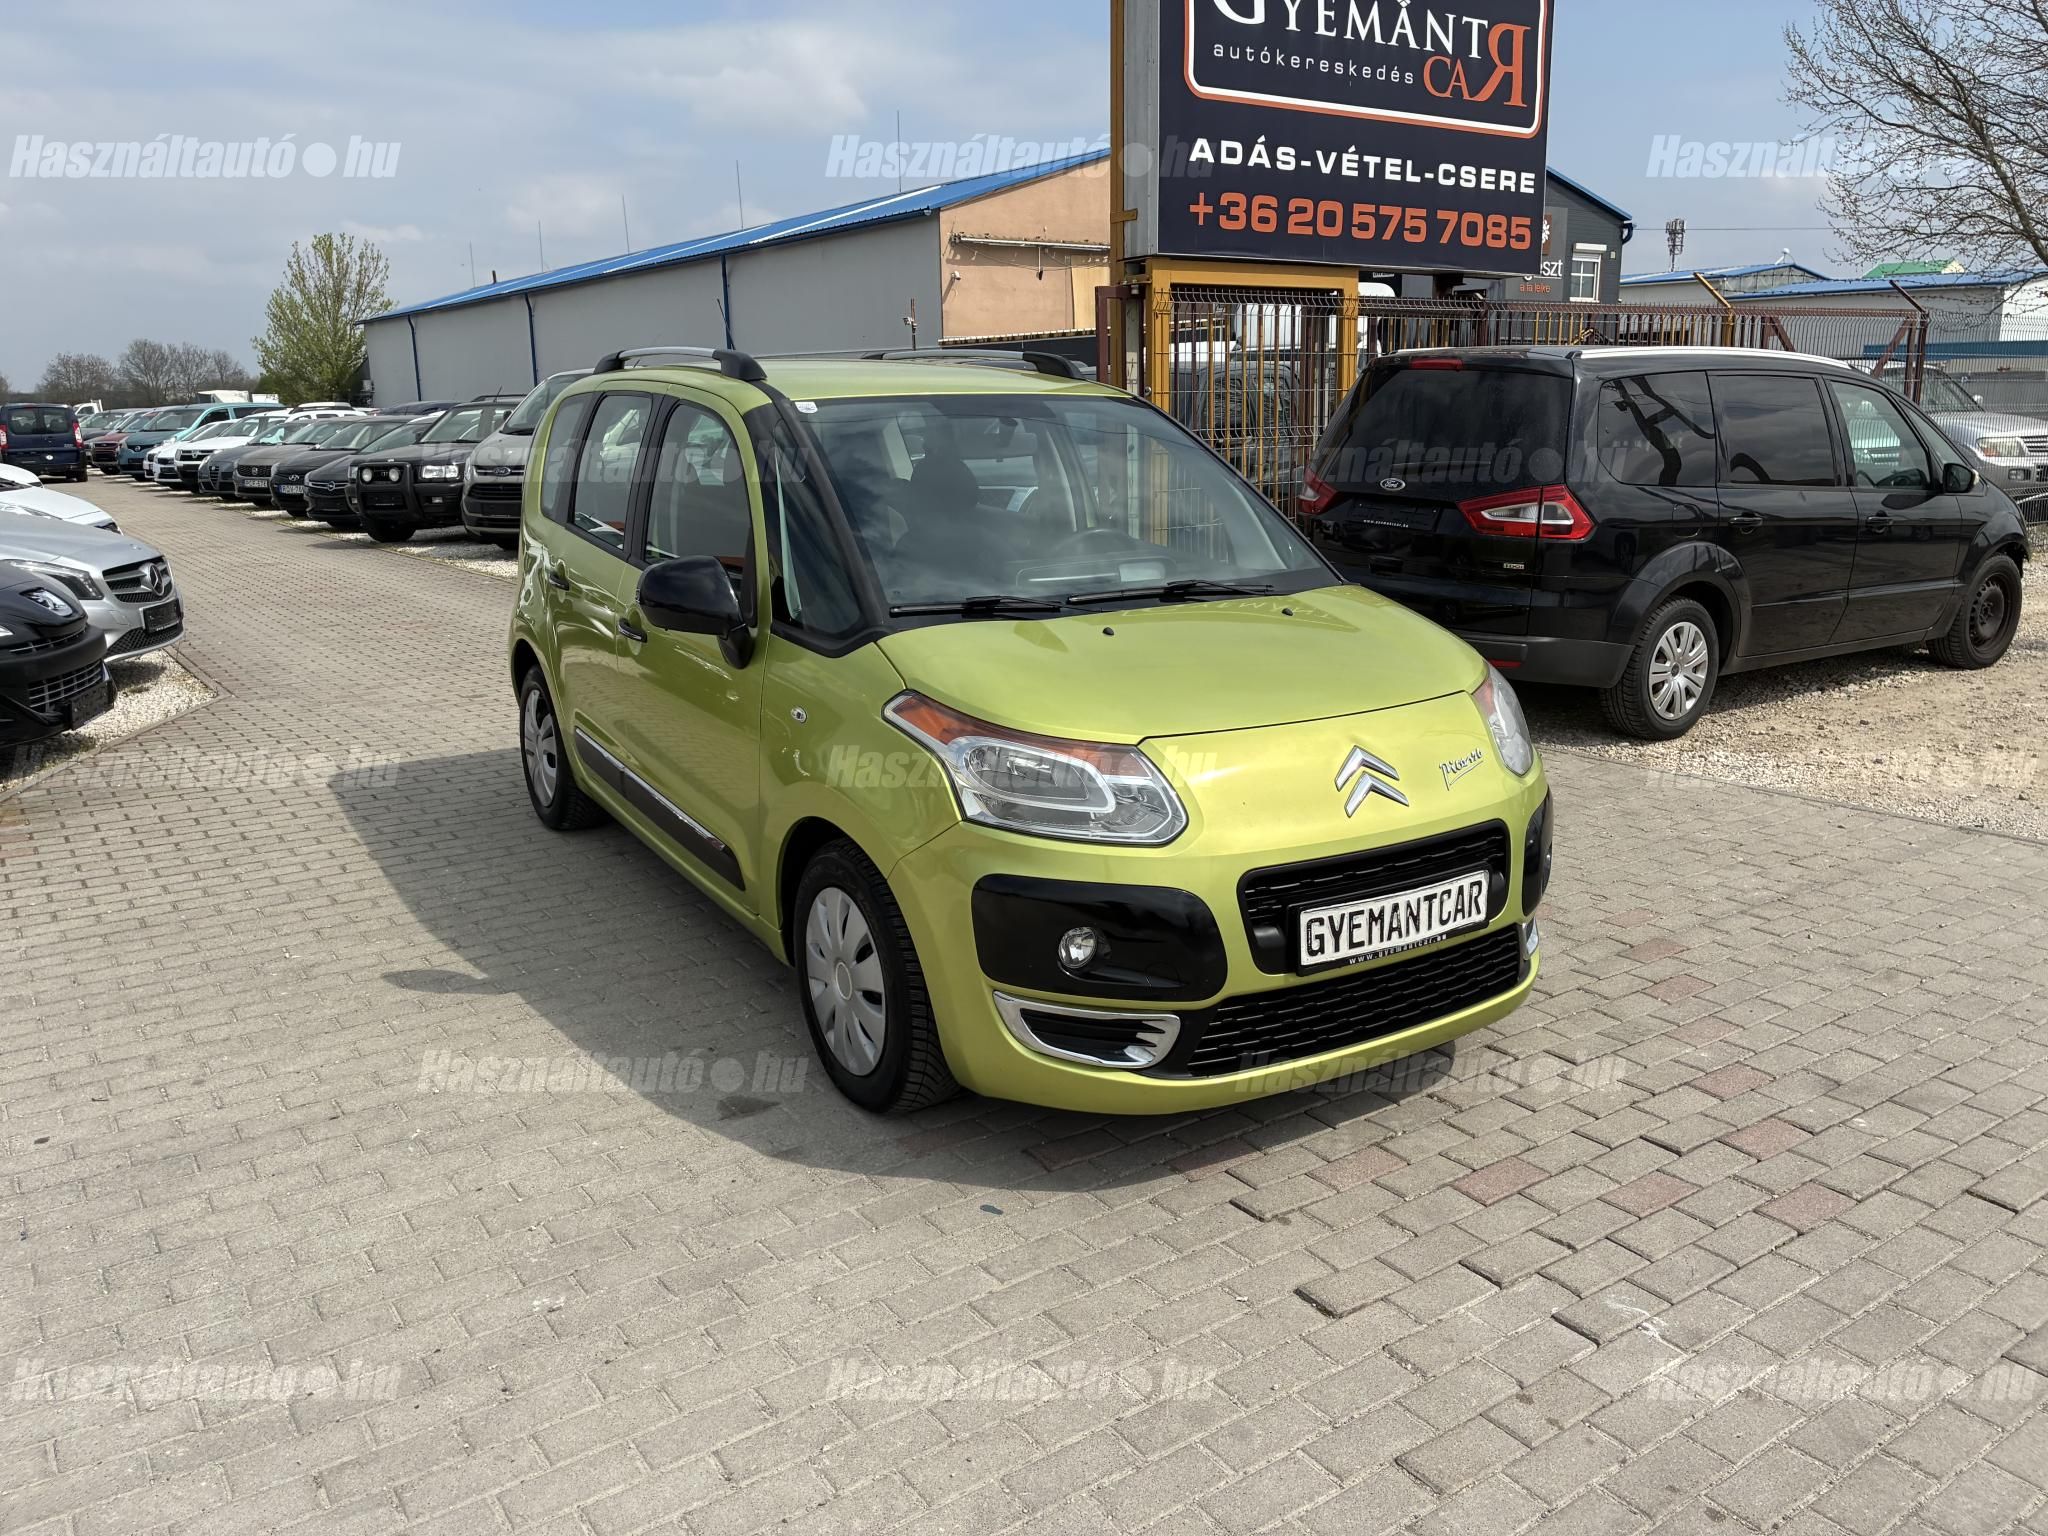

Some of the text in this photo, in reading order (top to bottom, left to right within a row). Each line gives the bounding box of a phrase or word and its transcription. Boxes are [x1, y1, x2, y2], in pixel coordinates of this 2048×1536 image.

[1212, 42, 1414, 85] autókereskedés
[1189, 135, 1536, 194] ADÁS-VÉTEL-CSERE
[1189, 192, 1532, 250] +36 20 575 7085
[1306, 879, 1484, 957] GYEMANTCAR
